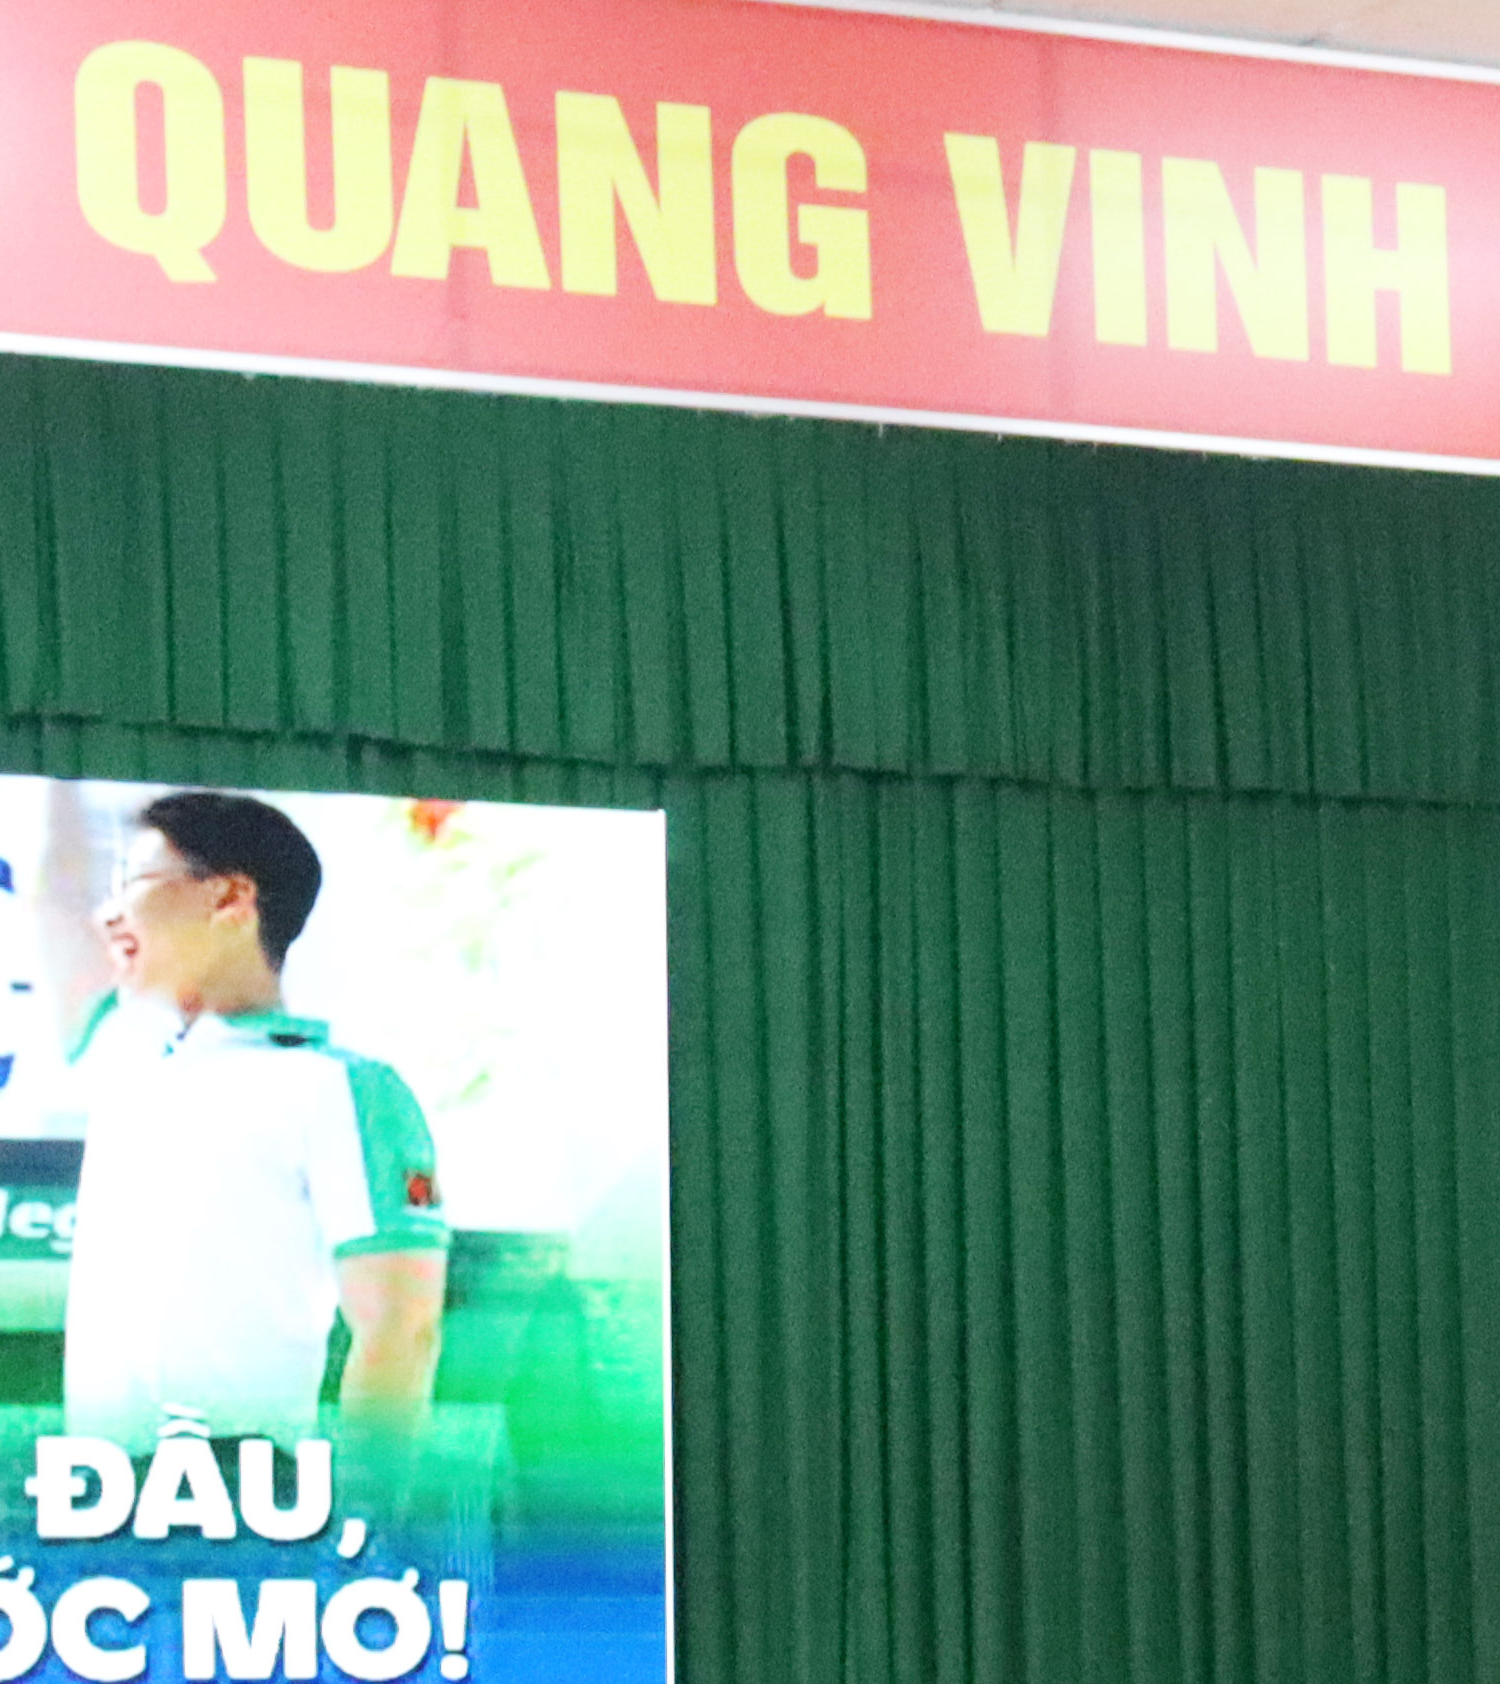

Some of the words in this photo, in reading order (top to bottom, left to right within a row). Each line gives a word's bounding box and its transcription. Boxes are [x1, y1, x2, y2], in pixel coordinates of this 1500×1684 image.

[74, 40, 874, 322] QUANG
[943, 130, 1453, 378] VINH
[23, 1402, 369, 1560] ĐẦU,
[181, 1566, 470, 1684] MƠ!
